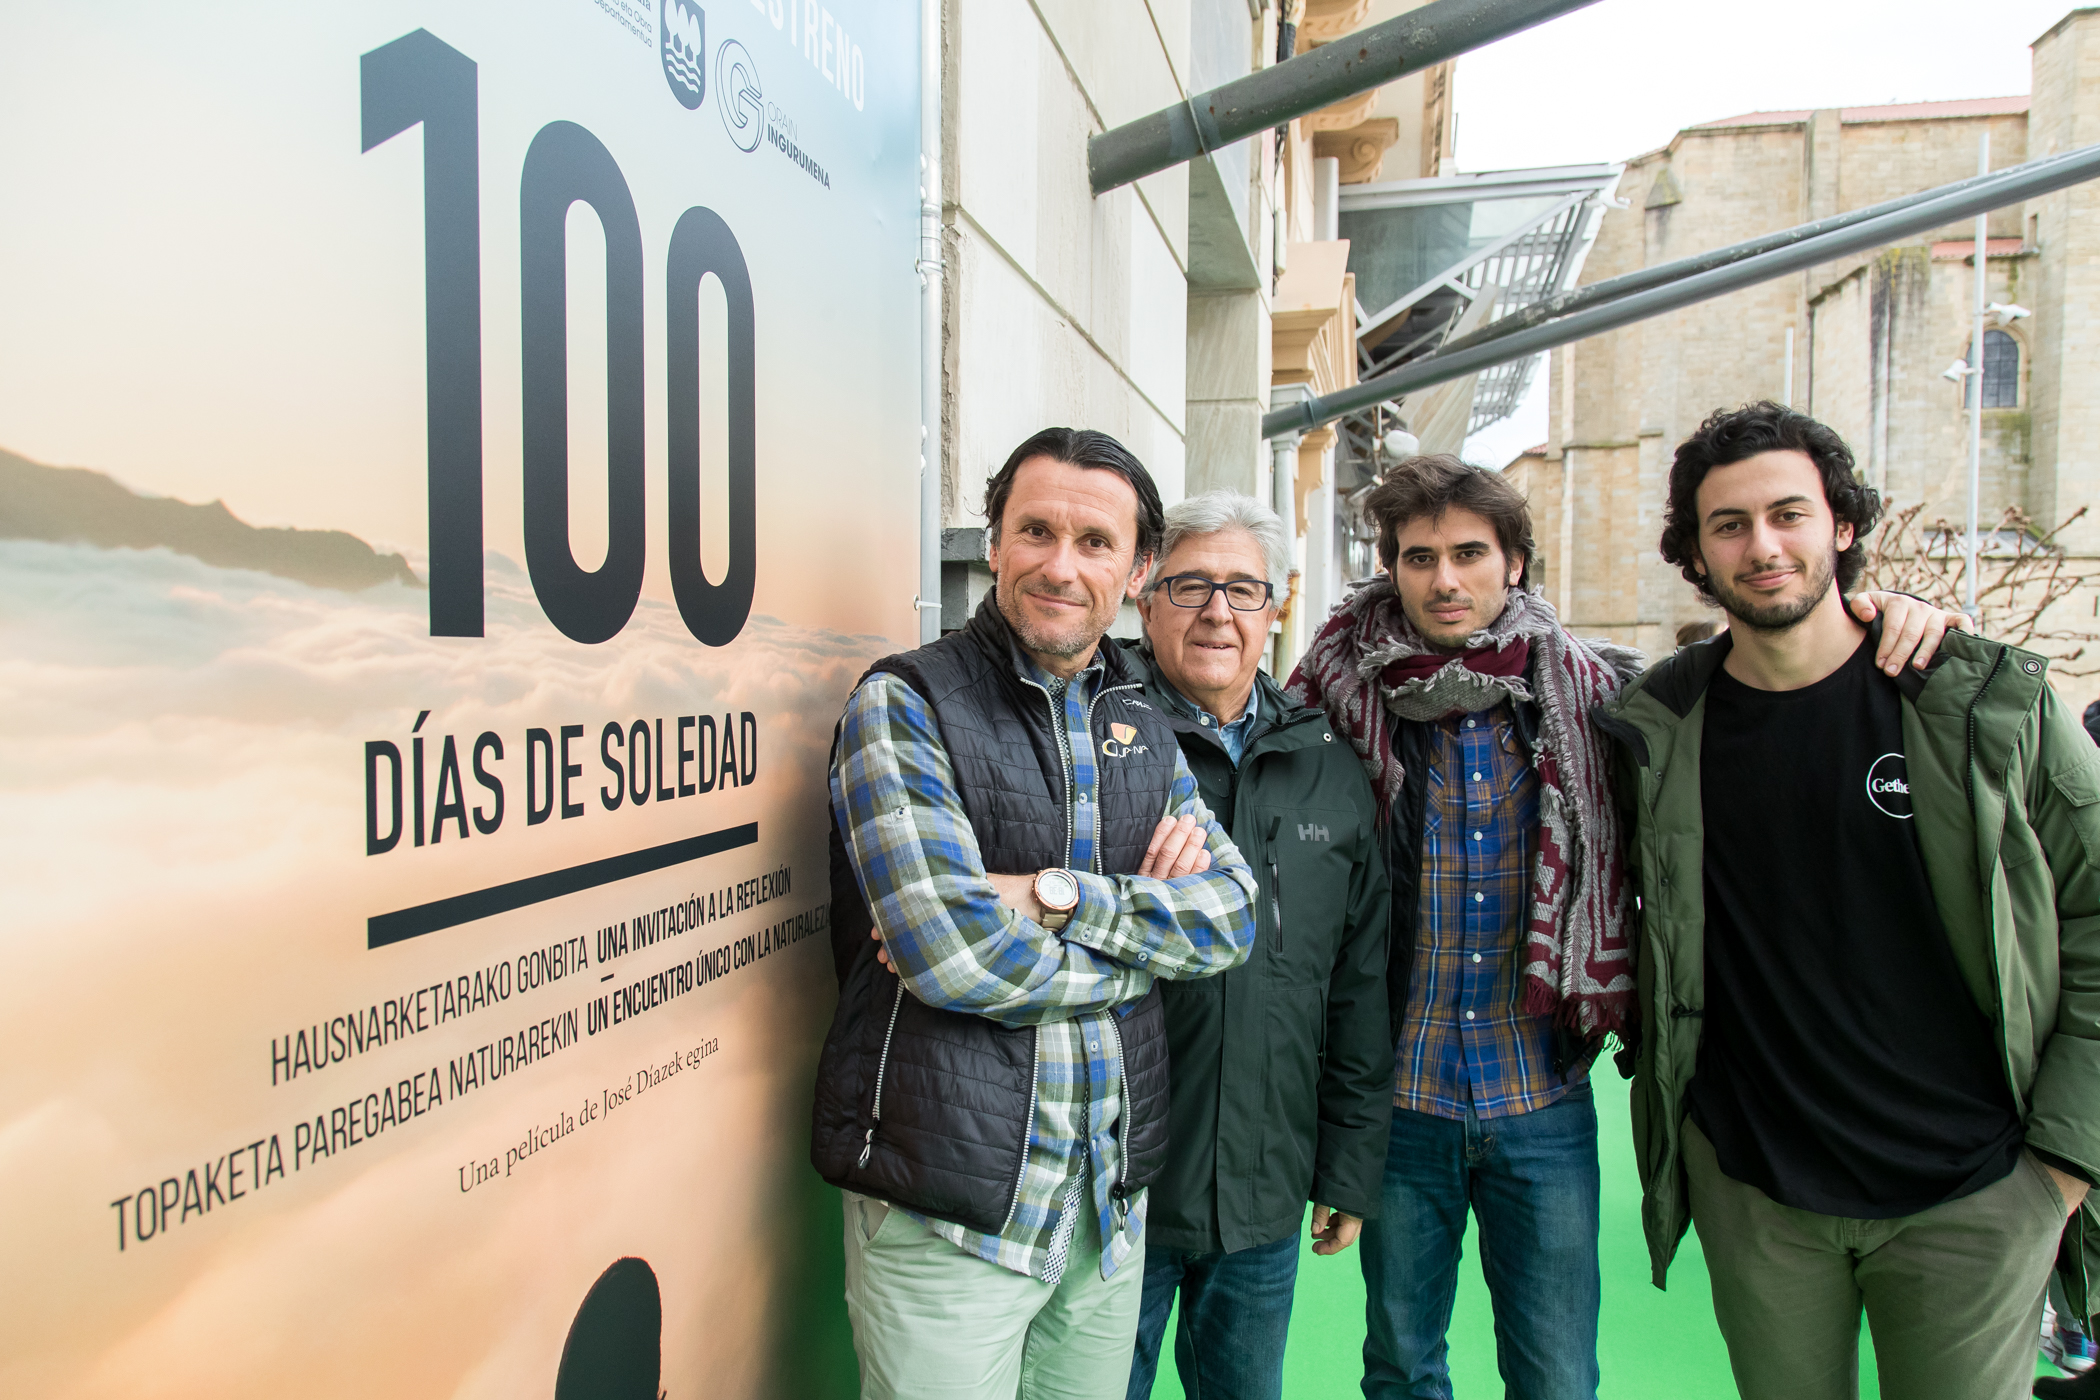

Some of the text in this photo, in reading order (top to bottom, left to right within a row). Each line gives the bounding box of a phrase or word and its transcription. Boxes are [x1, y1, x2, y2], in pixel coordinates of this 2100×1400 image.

[634, 11, 652, 33] Obra
[752, 0, 865, 112] TRENO
[768, 101, 798, 142] ORAIN
[768, 123, 831, 191] INGURUMENA
[360, 27, 756, 647] 100
[365, 710, 758, 857] DÍAS DE SOLEDAD
[1297, 823, 1330, 842] HH
[271, 864, 791, 1087] HAUSNARKETARAKO GONBITA UNA INVITACIÓN A LA REFLEXIÓN
[110, 1134, 285, 1252] TOPAKETA
[294, 1066, 443, 1172] PAREGABEA
[449, 1007, 579, 1101] NATURAREKIN
[587, 995, 609, 1036] UN
[613, 960, 693, 1026] ENCUENTRO
[696, 949, 731, 988] ÚNICO
[733, 933, 755, 970] CON
[758, 928, 771, 960] LA
[458, 1037, 719, 1193] Una película de José Díazek egina
